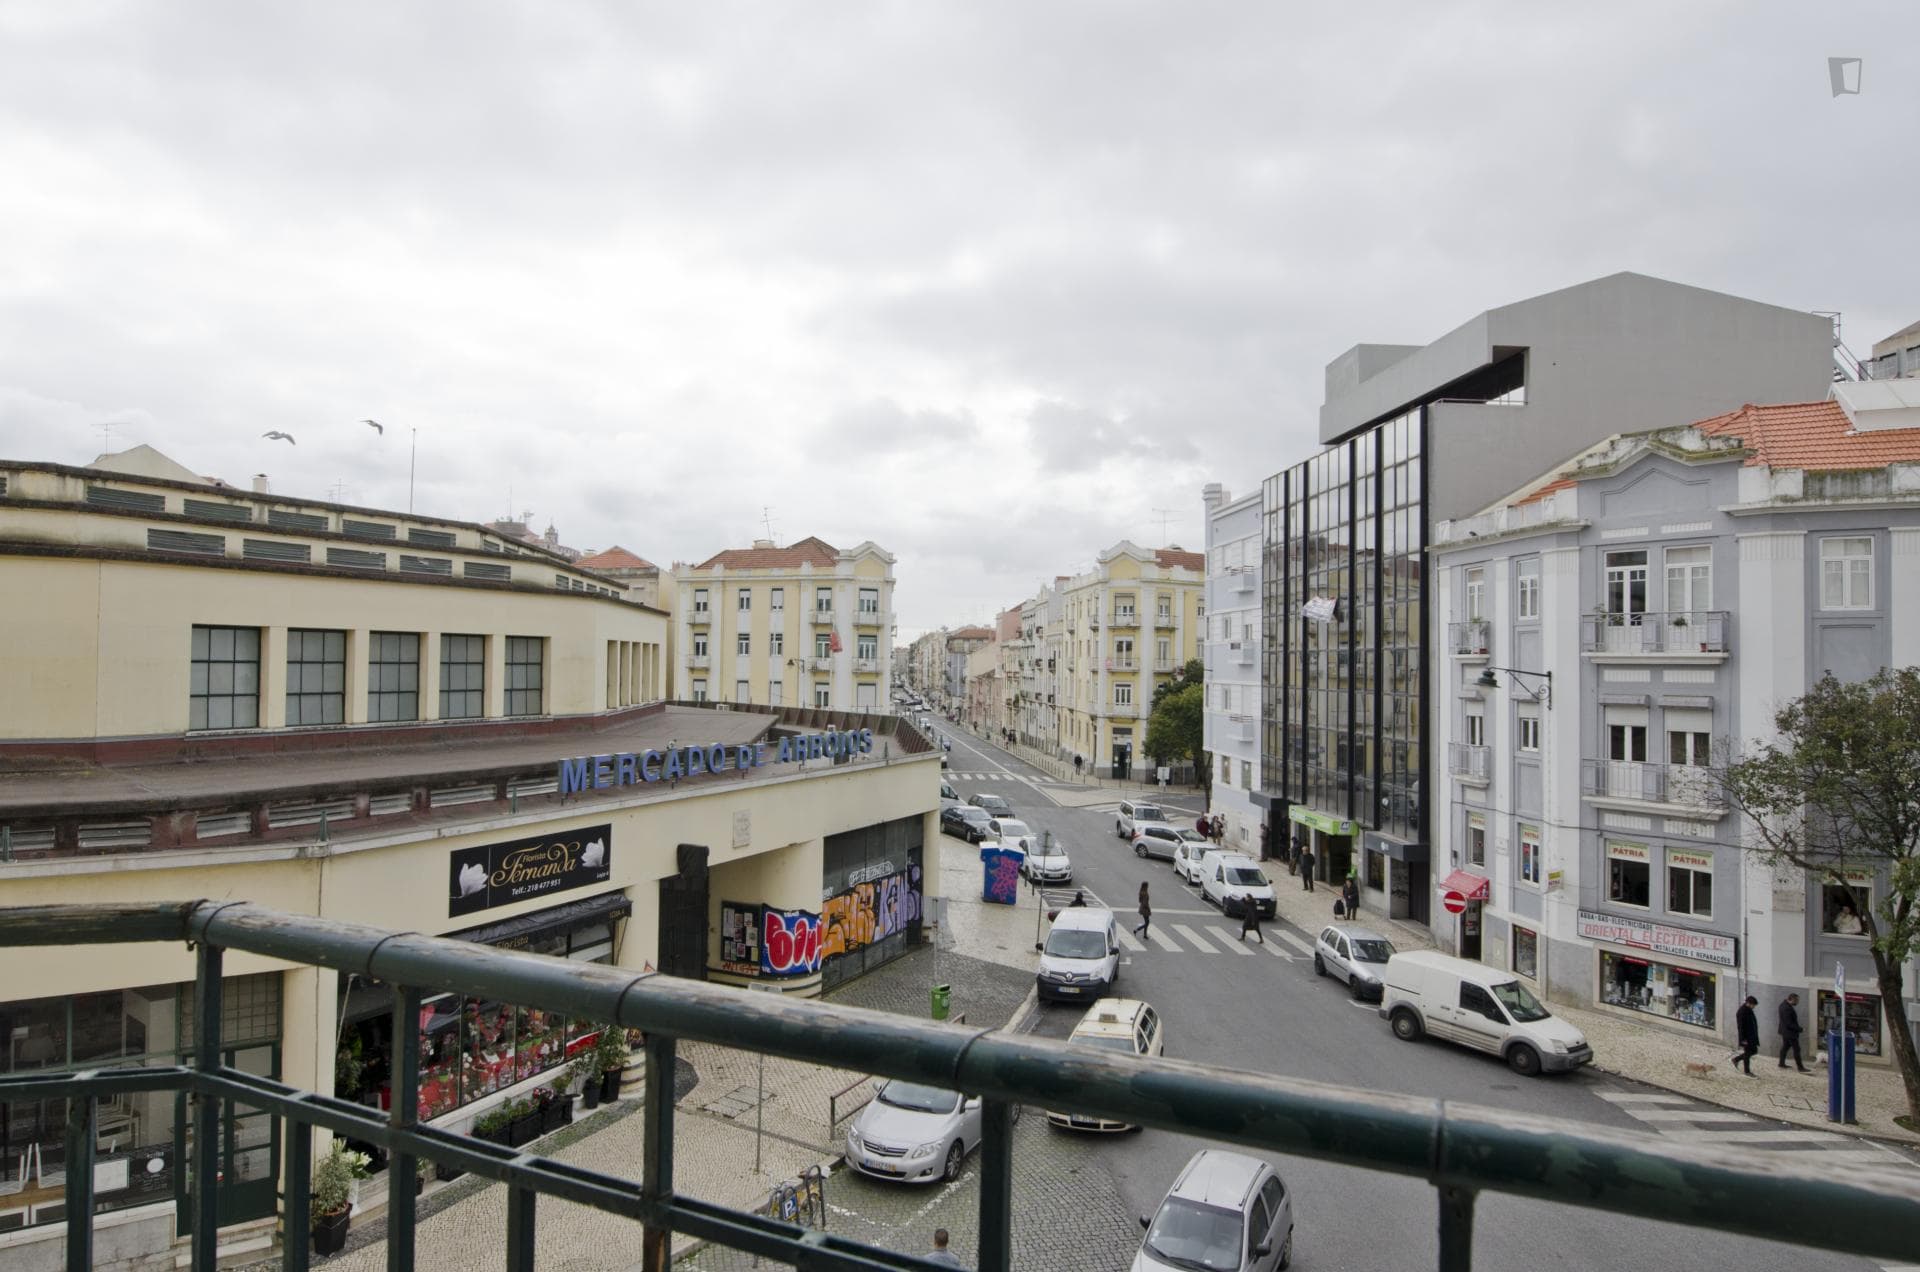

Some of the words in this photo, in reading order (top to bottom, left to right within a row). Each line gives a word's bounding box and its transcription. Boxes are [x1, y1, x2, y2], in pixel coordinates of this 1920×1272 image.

[558, 742, 726, 794] MERCADO
[735, 743, 766, 770] DE
[775, 728, 873, 764] ARROIOS
[490, 842, 581, 888] Fernanda
[523, 852, 546, 863] Florista
[527, 884, 538, 893] 218
[538, 881, 550, 891] 477
[549, 878, 561, 888] 951
[1584, 923, 1633, 941] ORIENTAL
